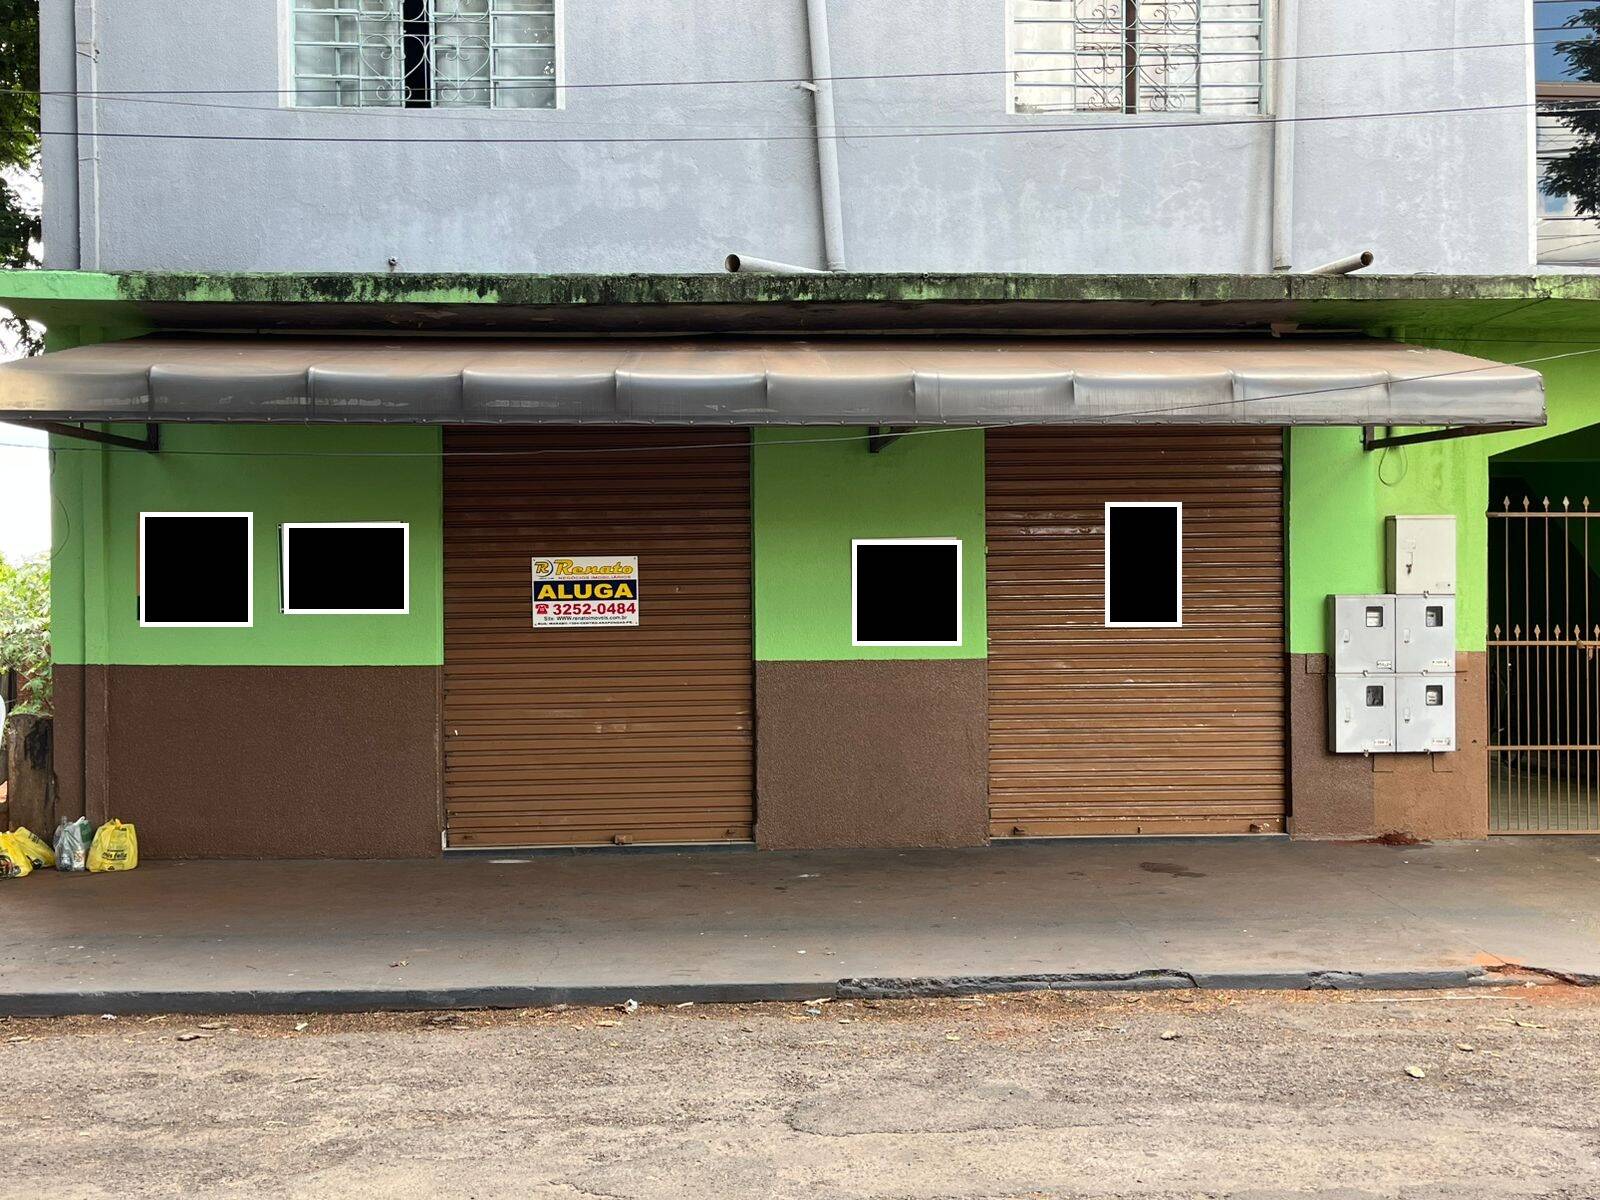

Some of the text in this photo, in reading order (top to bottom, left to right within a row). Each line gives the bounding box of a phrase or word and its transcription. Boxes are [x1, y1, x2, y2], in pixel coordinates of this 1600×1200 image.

[553, 559, 634, 576] Renato
[537, 583, 634, 600] ALUGA
[553, 603, 636, 615] 3252-0484
